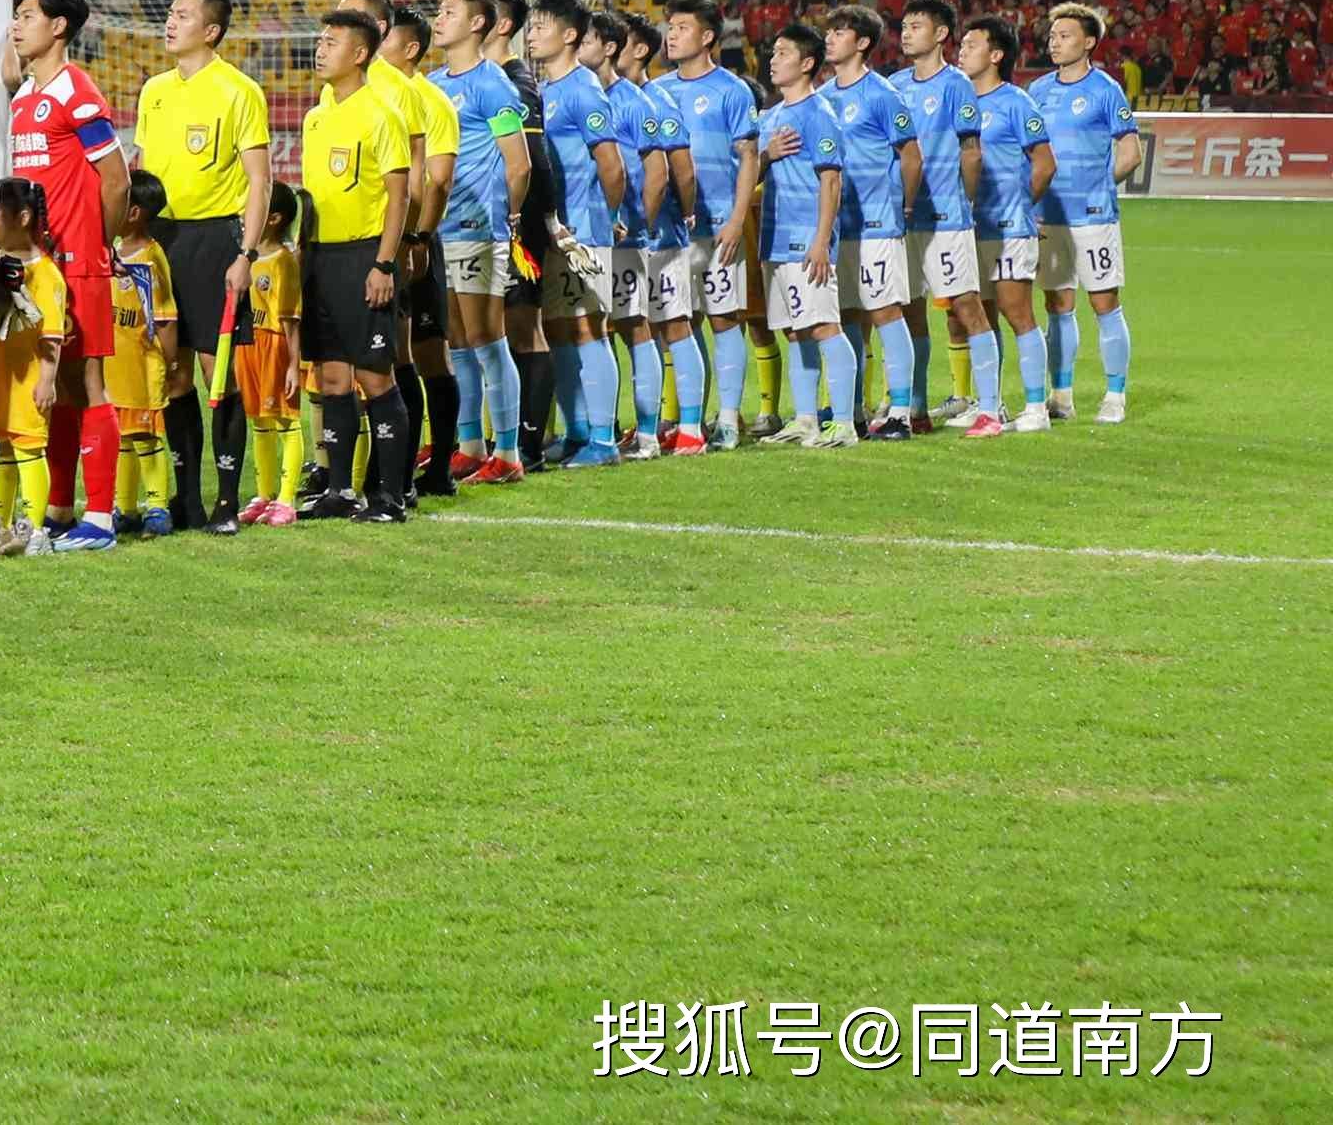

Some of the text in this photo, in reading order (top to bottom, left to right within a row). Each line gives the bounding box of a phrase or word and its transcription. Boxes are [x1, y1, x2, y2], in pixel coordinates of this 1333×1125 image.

[939, 251, 954, 276] 5
[995, 258, 1014, 280] 11
[1086, 247, 1112, 271] 18
[612, 269, 638, 298] 29
[702, 267, 732, 294] 53
[860, 261, 886, 287] 47
[648, 273, 676, 302] 24
[788, 285, 802, 310] 3
